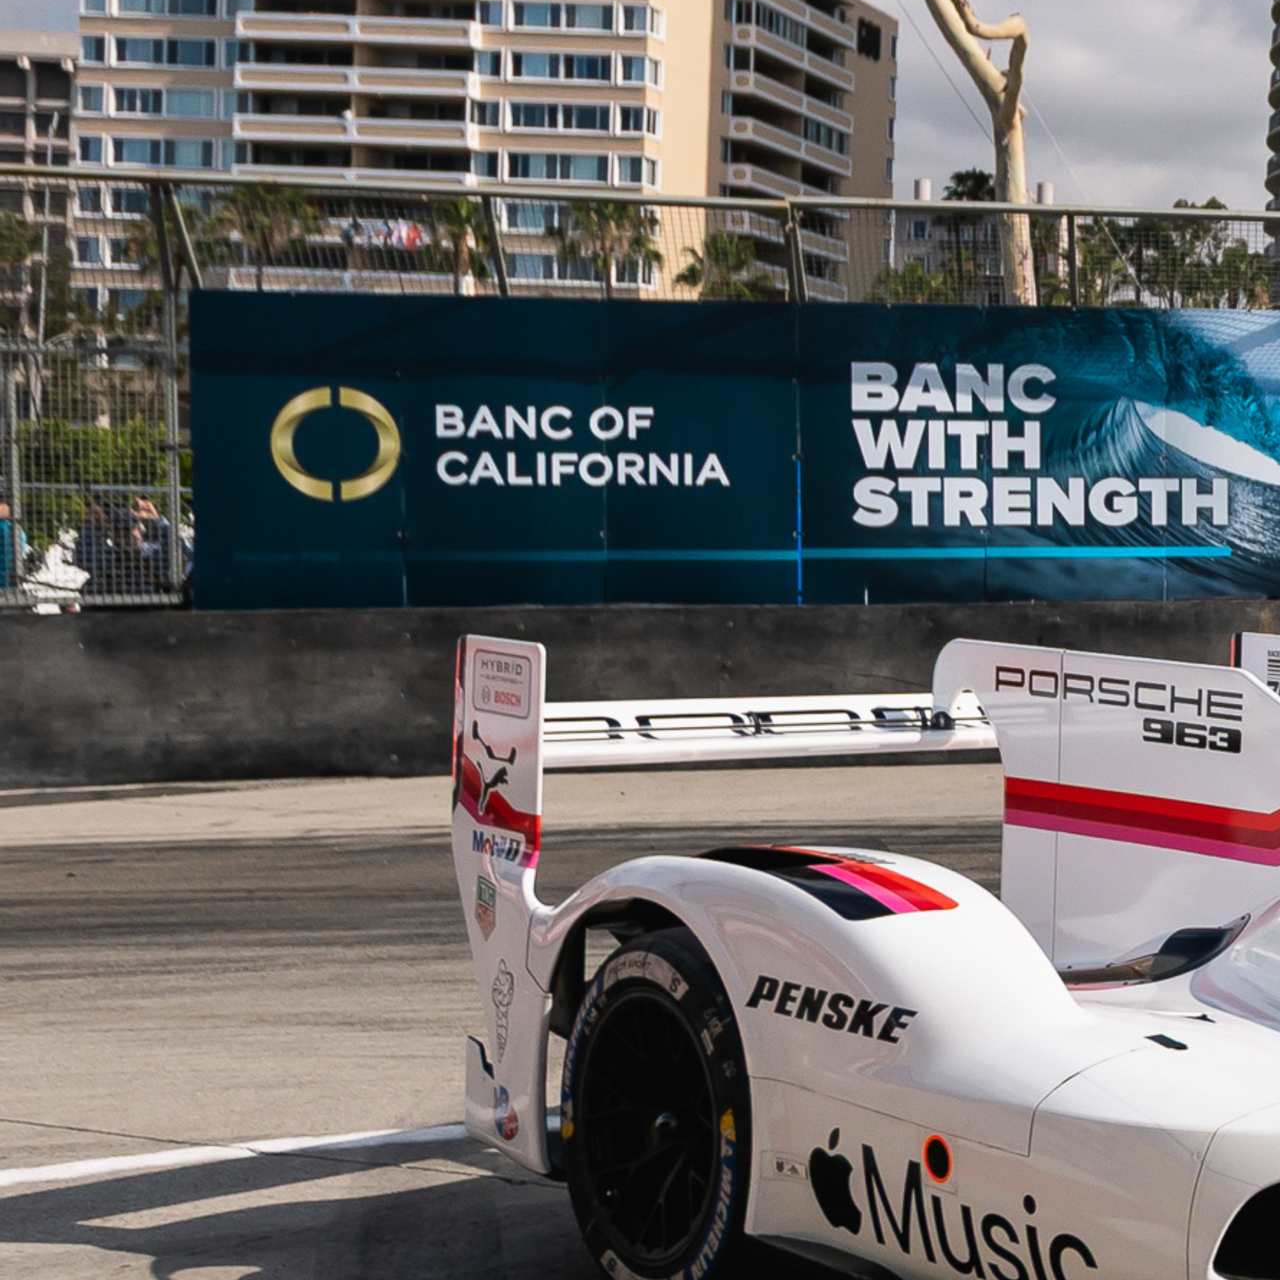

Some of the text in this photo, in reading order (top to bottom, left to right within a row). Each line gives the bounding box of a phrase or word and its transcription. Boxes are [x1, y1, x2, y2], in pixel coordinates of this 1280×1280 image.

[851, 361, 1057, 412] BANC
[435, 405, 654, 441] BANC OF
[851, 418, 1041, 471] WITH
[434, 449, 731, 488] CALIFORNIA
[850, 476, 1231, 528] STRENGTH
[480, 660, 523, 676] HYBRID
[995, 665, 1243, 722] PORSCHE
[1142, 717, 1242, 754] 963
[745, 974, 920, 1045] PENSKE
